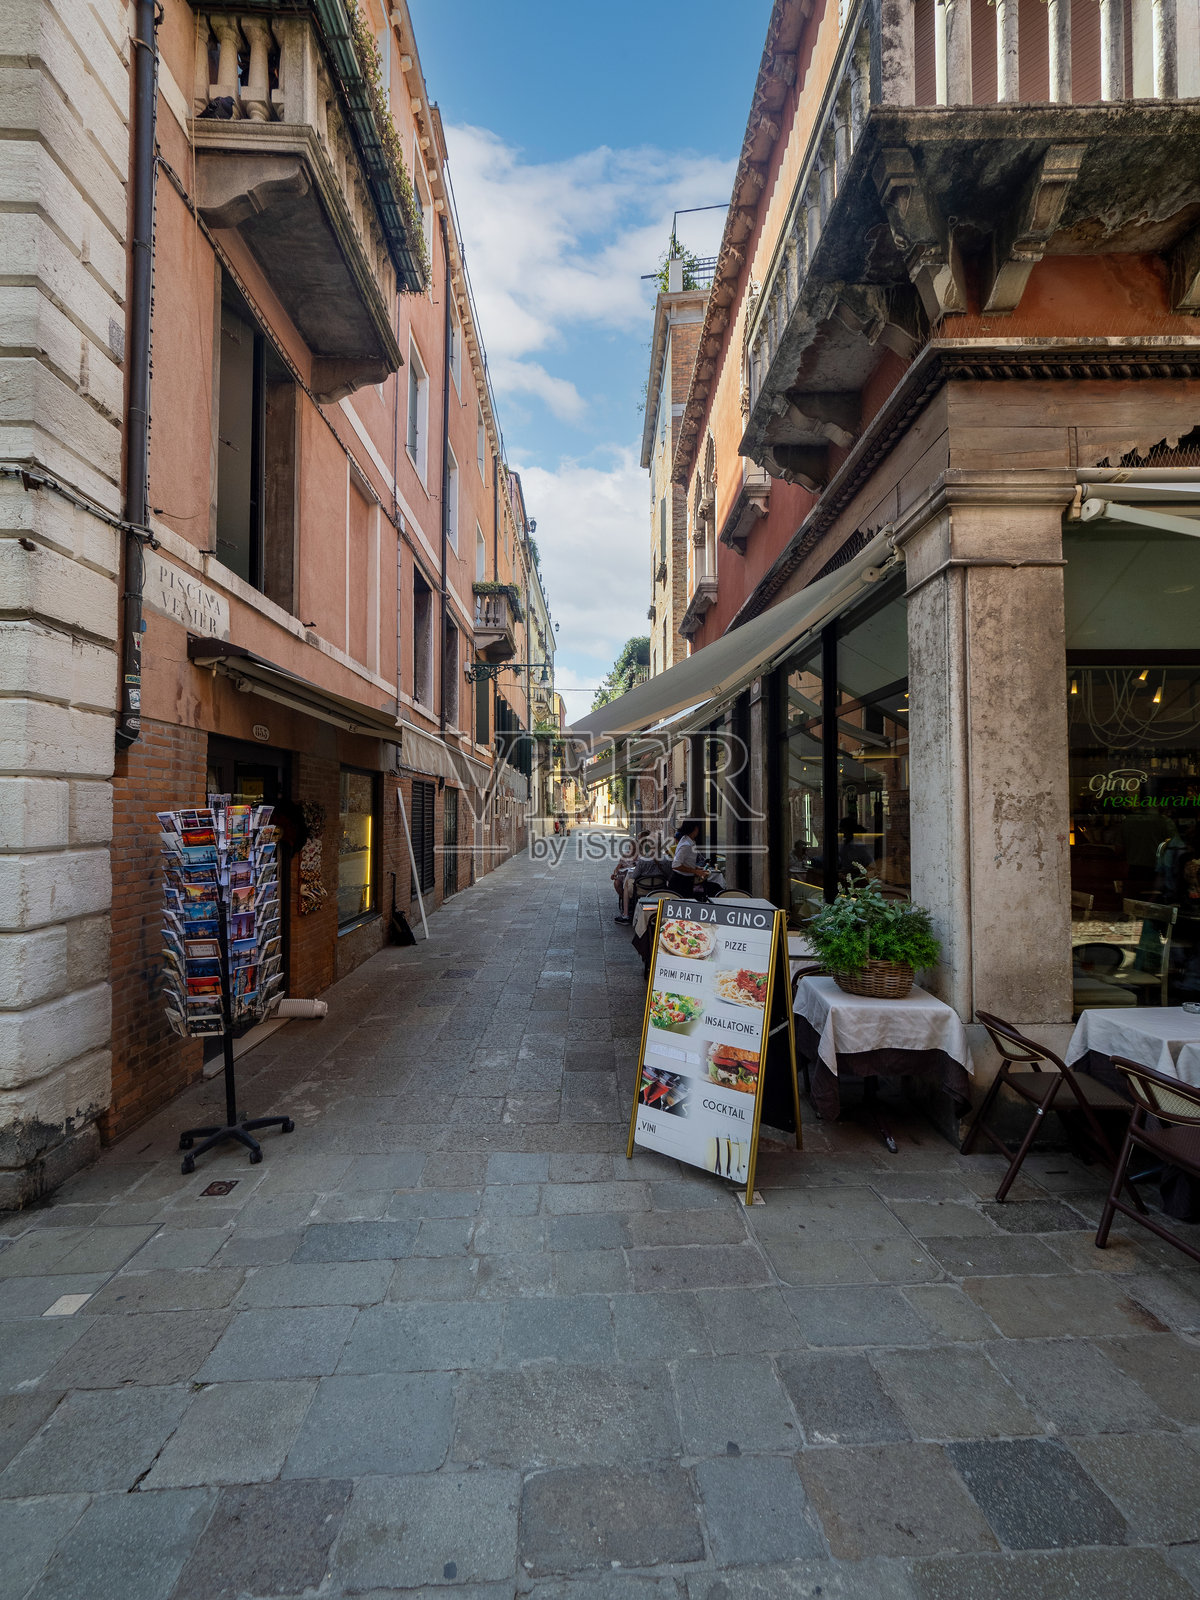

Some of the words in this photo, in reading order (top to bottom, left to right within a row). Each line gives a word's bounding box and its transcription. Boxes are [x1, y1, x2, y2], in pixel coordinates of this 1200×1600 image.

[160, 565, 221, 616] PISCINA
[666, 904, 692, 920] BAR
[700, 908, 718, 923] DA
[726, 911, 767, 928] GINO
[724, 940, 747, 952] PIZZE
[659, 968, 678, 979] PRIMI
[680, 971, 703, 984] PIATTI
[705, 1015, 755, 1035] INSALATONE
[702, 1099, 746, 1121] COCKTAIL
[641, 1120, 657, 1134] VINI
